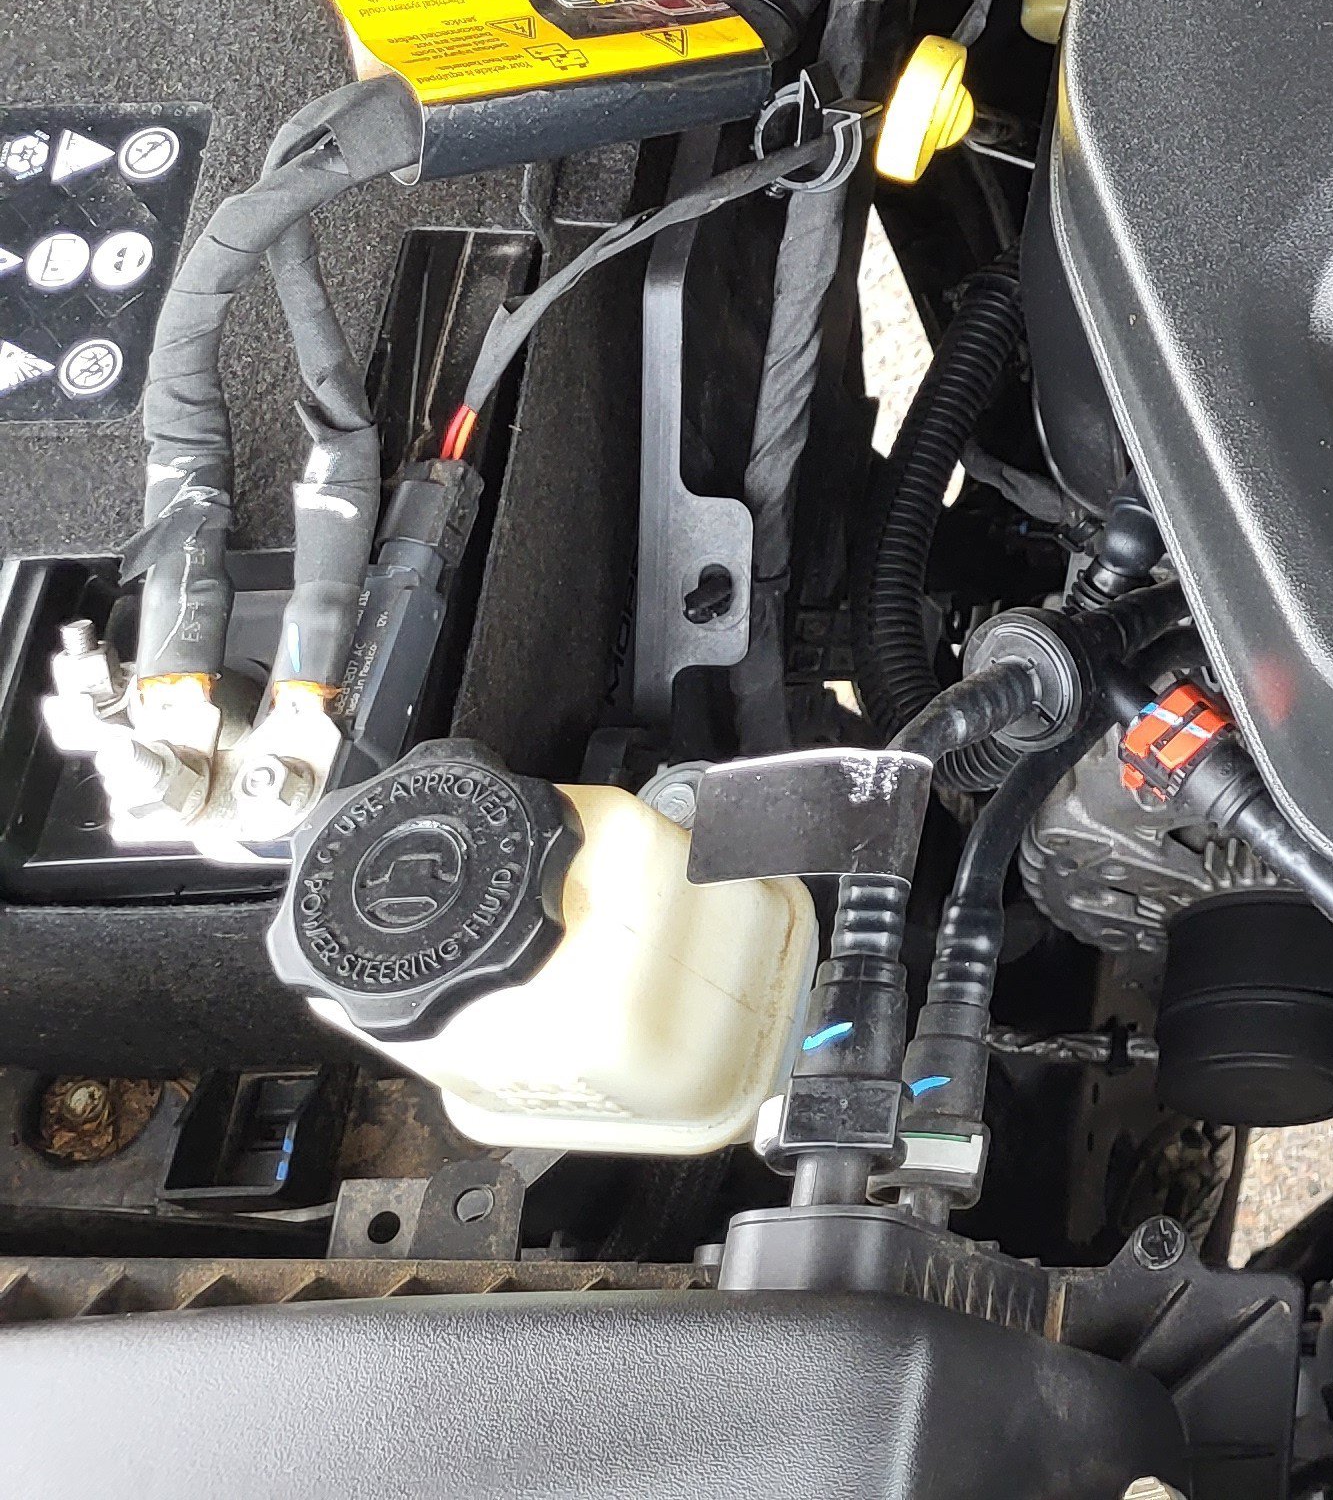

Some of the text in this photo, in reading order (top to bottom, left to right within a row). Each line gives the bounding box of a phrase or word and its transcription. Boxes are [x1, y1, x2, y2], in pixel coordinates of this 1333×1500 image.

[358, 6, 387, 18] could
[387, 1, 421, 12] system
[386, 34, 420, 44] before
[474, 64, 509, 74] vehicle
[510, 61, 533, 69] Your
[416, 71, 464, 84] equipped
[354, 678, 366, 691] in
[333, 772, 510, 835] USE APPROVED
[301, 868, 512, 984] POWER STEERING FLUID
